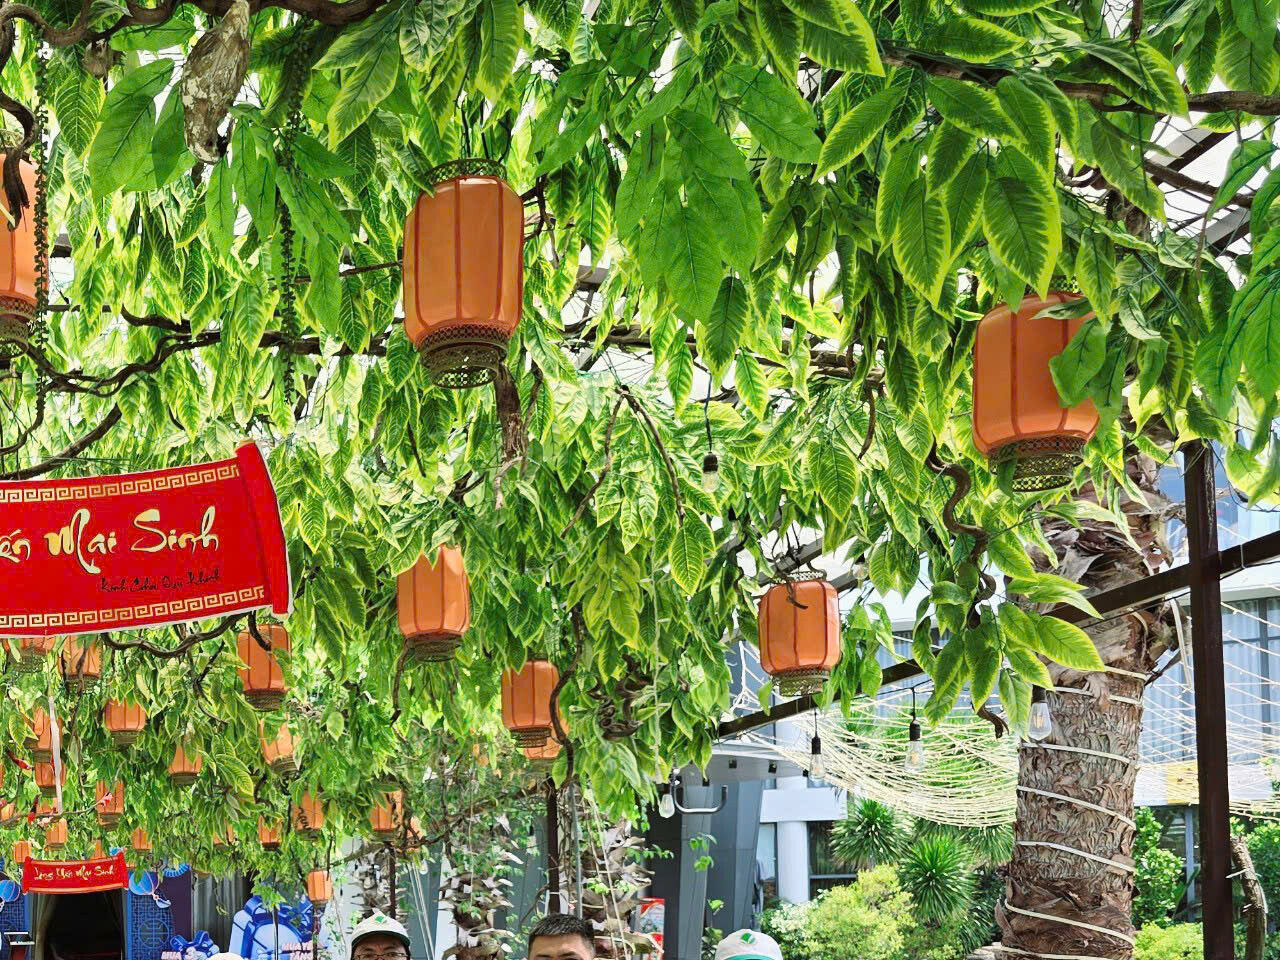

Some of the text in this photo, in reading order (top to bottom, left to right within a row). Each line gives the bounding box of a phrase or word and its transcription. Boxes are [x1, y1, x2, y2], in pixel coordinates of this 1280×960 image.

[43, 508, 119, 575] Mai
[129, 505, 219, 554] Sinh
[161, 951, 182, 960] MUA
